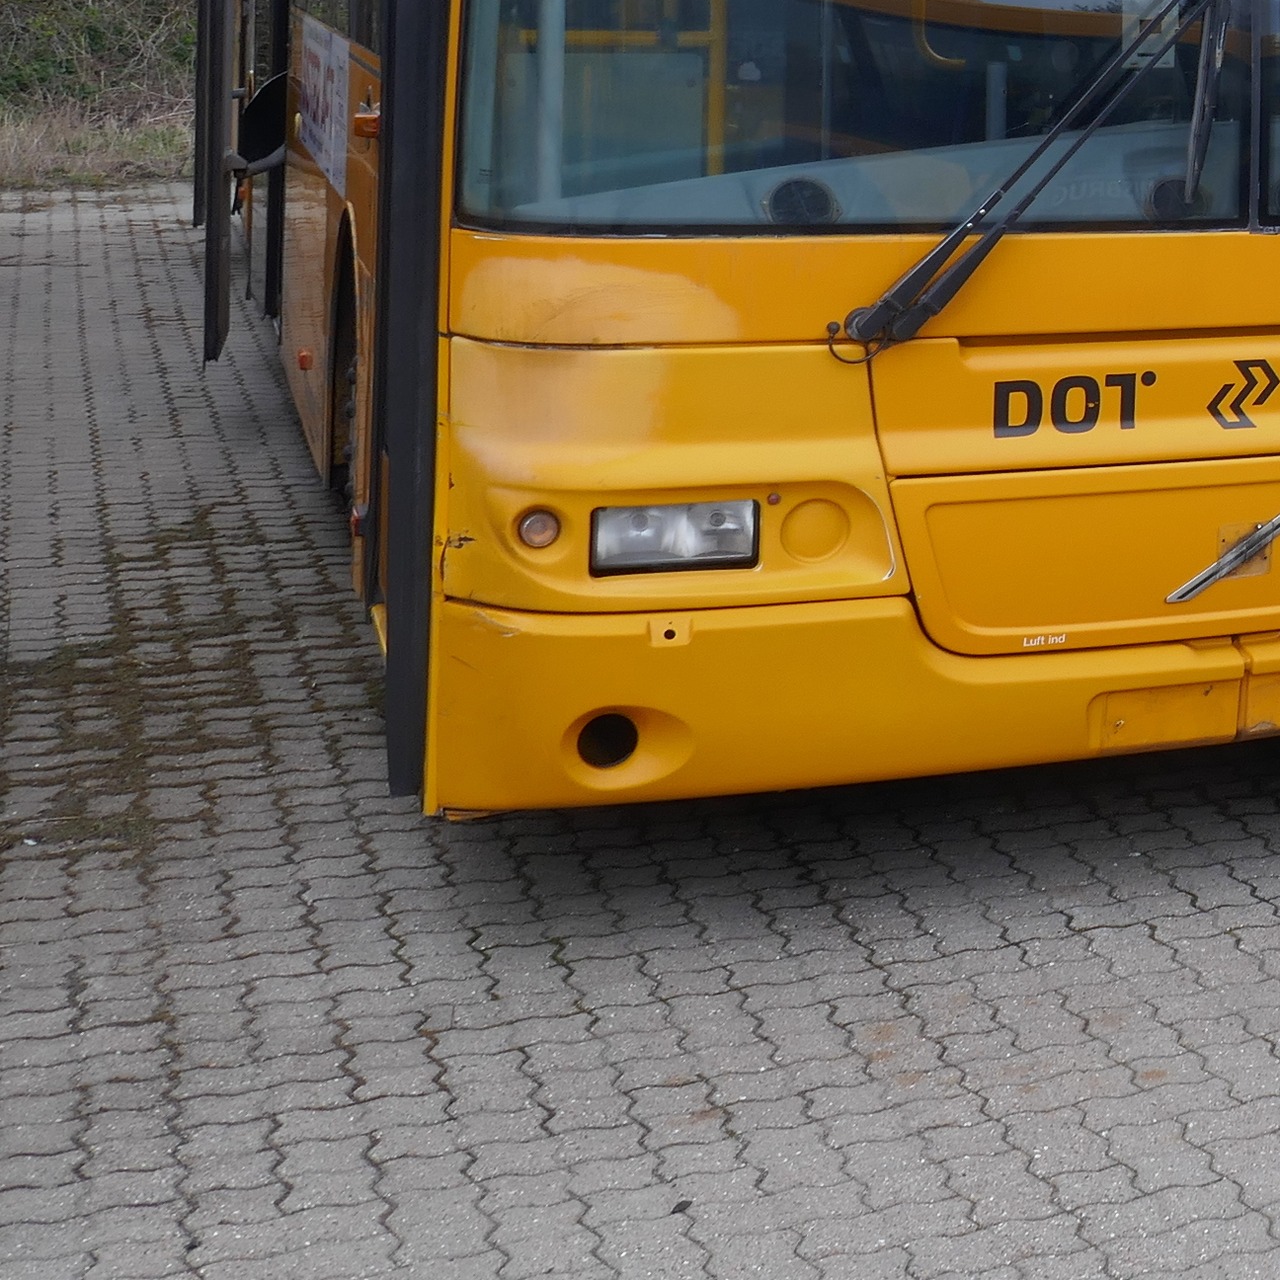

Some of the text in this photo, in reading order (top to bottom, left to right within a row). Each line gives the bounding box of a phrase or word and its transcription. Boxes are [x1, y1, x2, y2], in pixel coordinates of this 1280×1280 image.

[993, 372, 1140, 439] DOT
[1023, 633, 1066, 647] Luft ind
